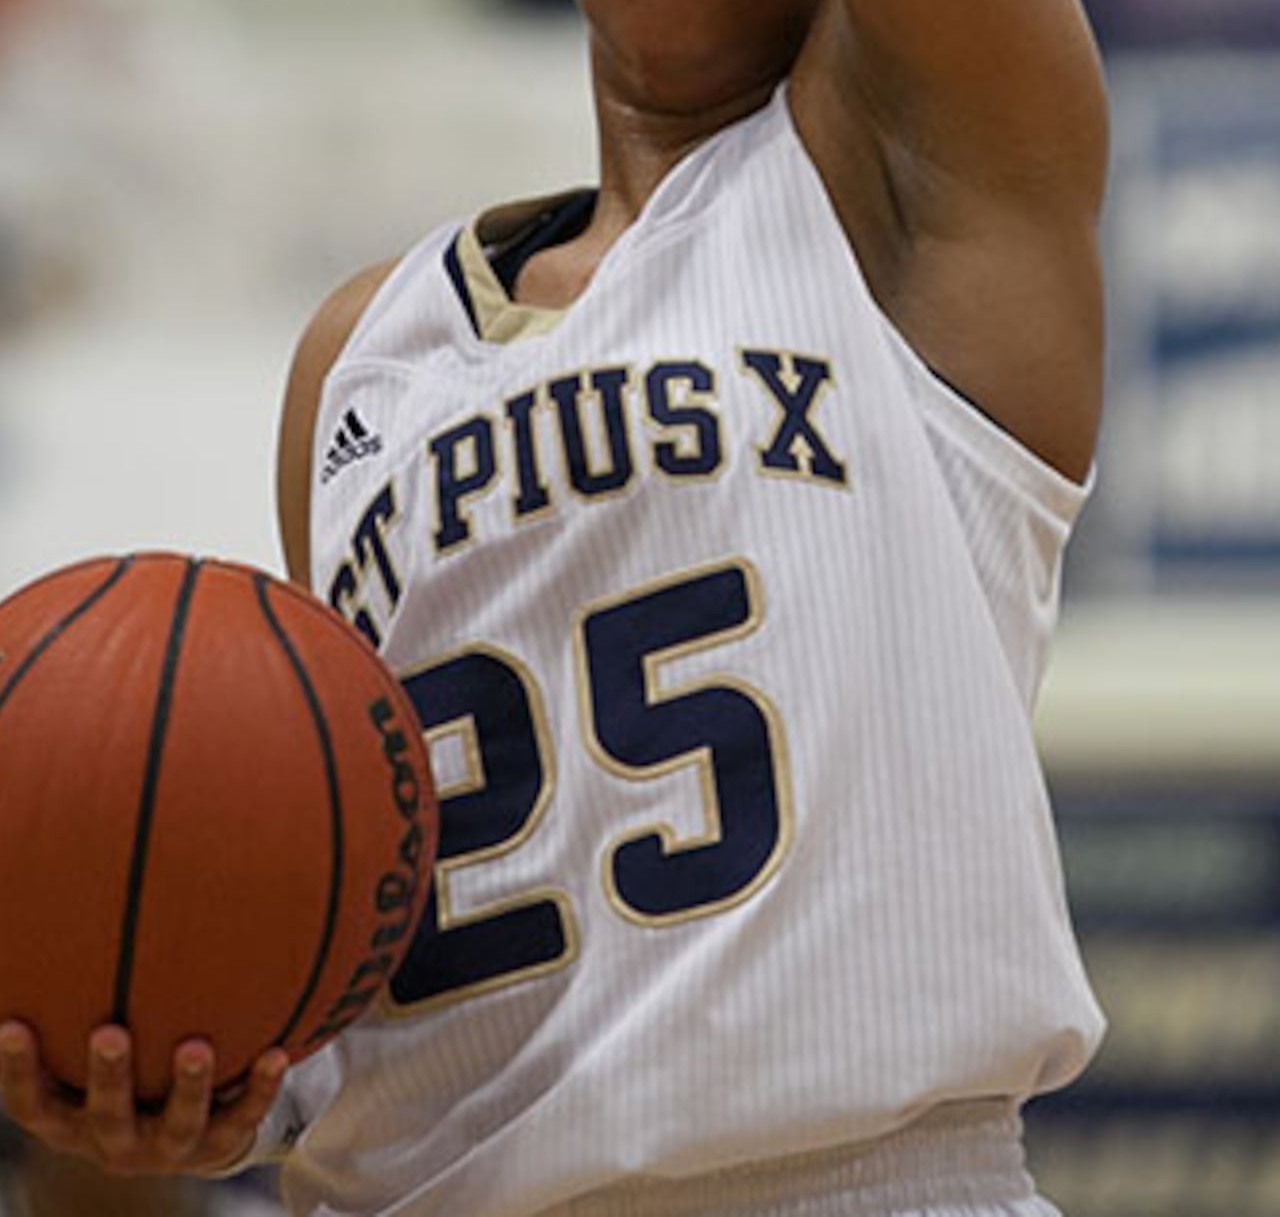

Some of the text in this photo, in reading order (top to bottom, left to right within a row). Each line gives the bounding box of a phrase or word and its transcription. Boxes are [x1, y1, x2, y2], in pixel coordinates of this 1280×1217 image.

[320, 433, 384, 485] adidas
[427, 358, 724, 556] PIUS
[739, 347, 852, 488] X
[382, 555, 794, 1018] 25
